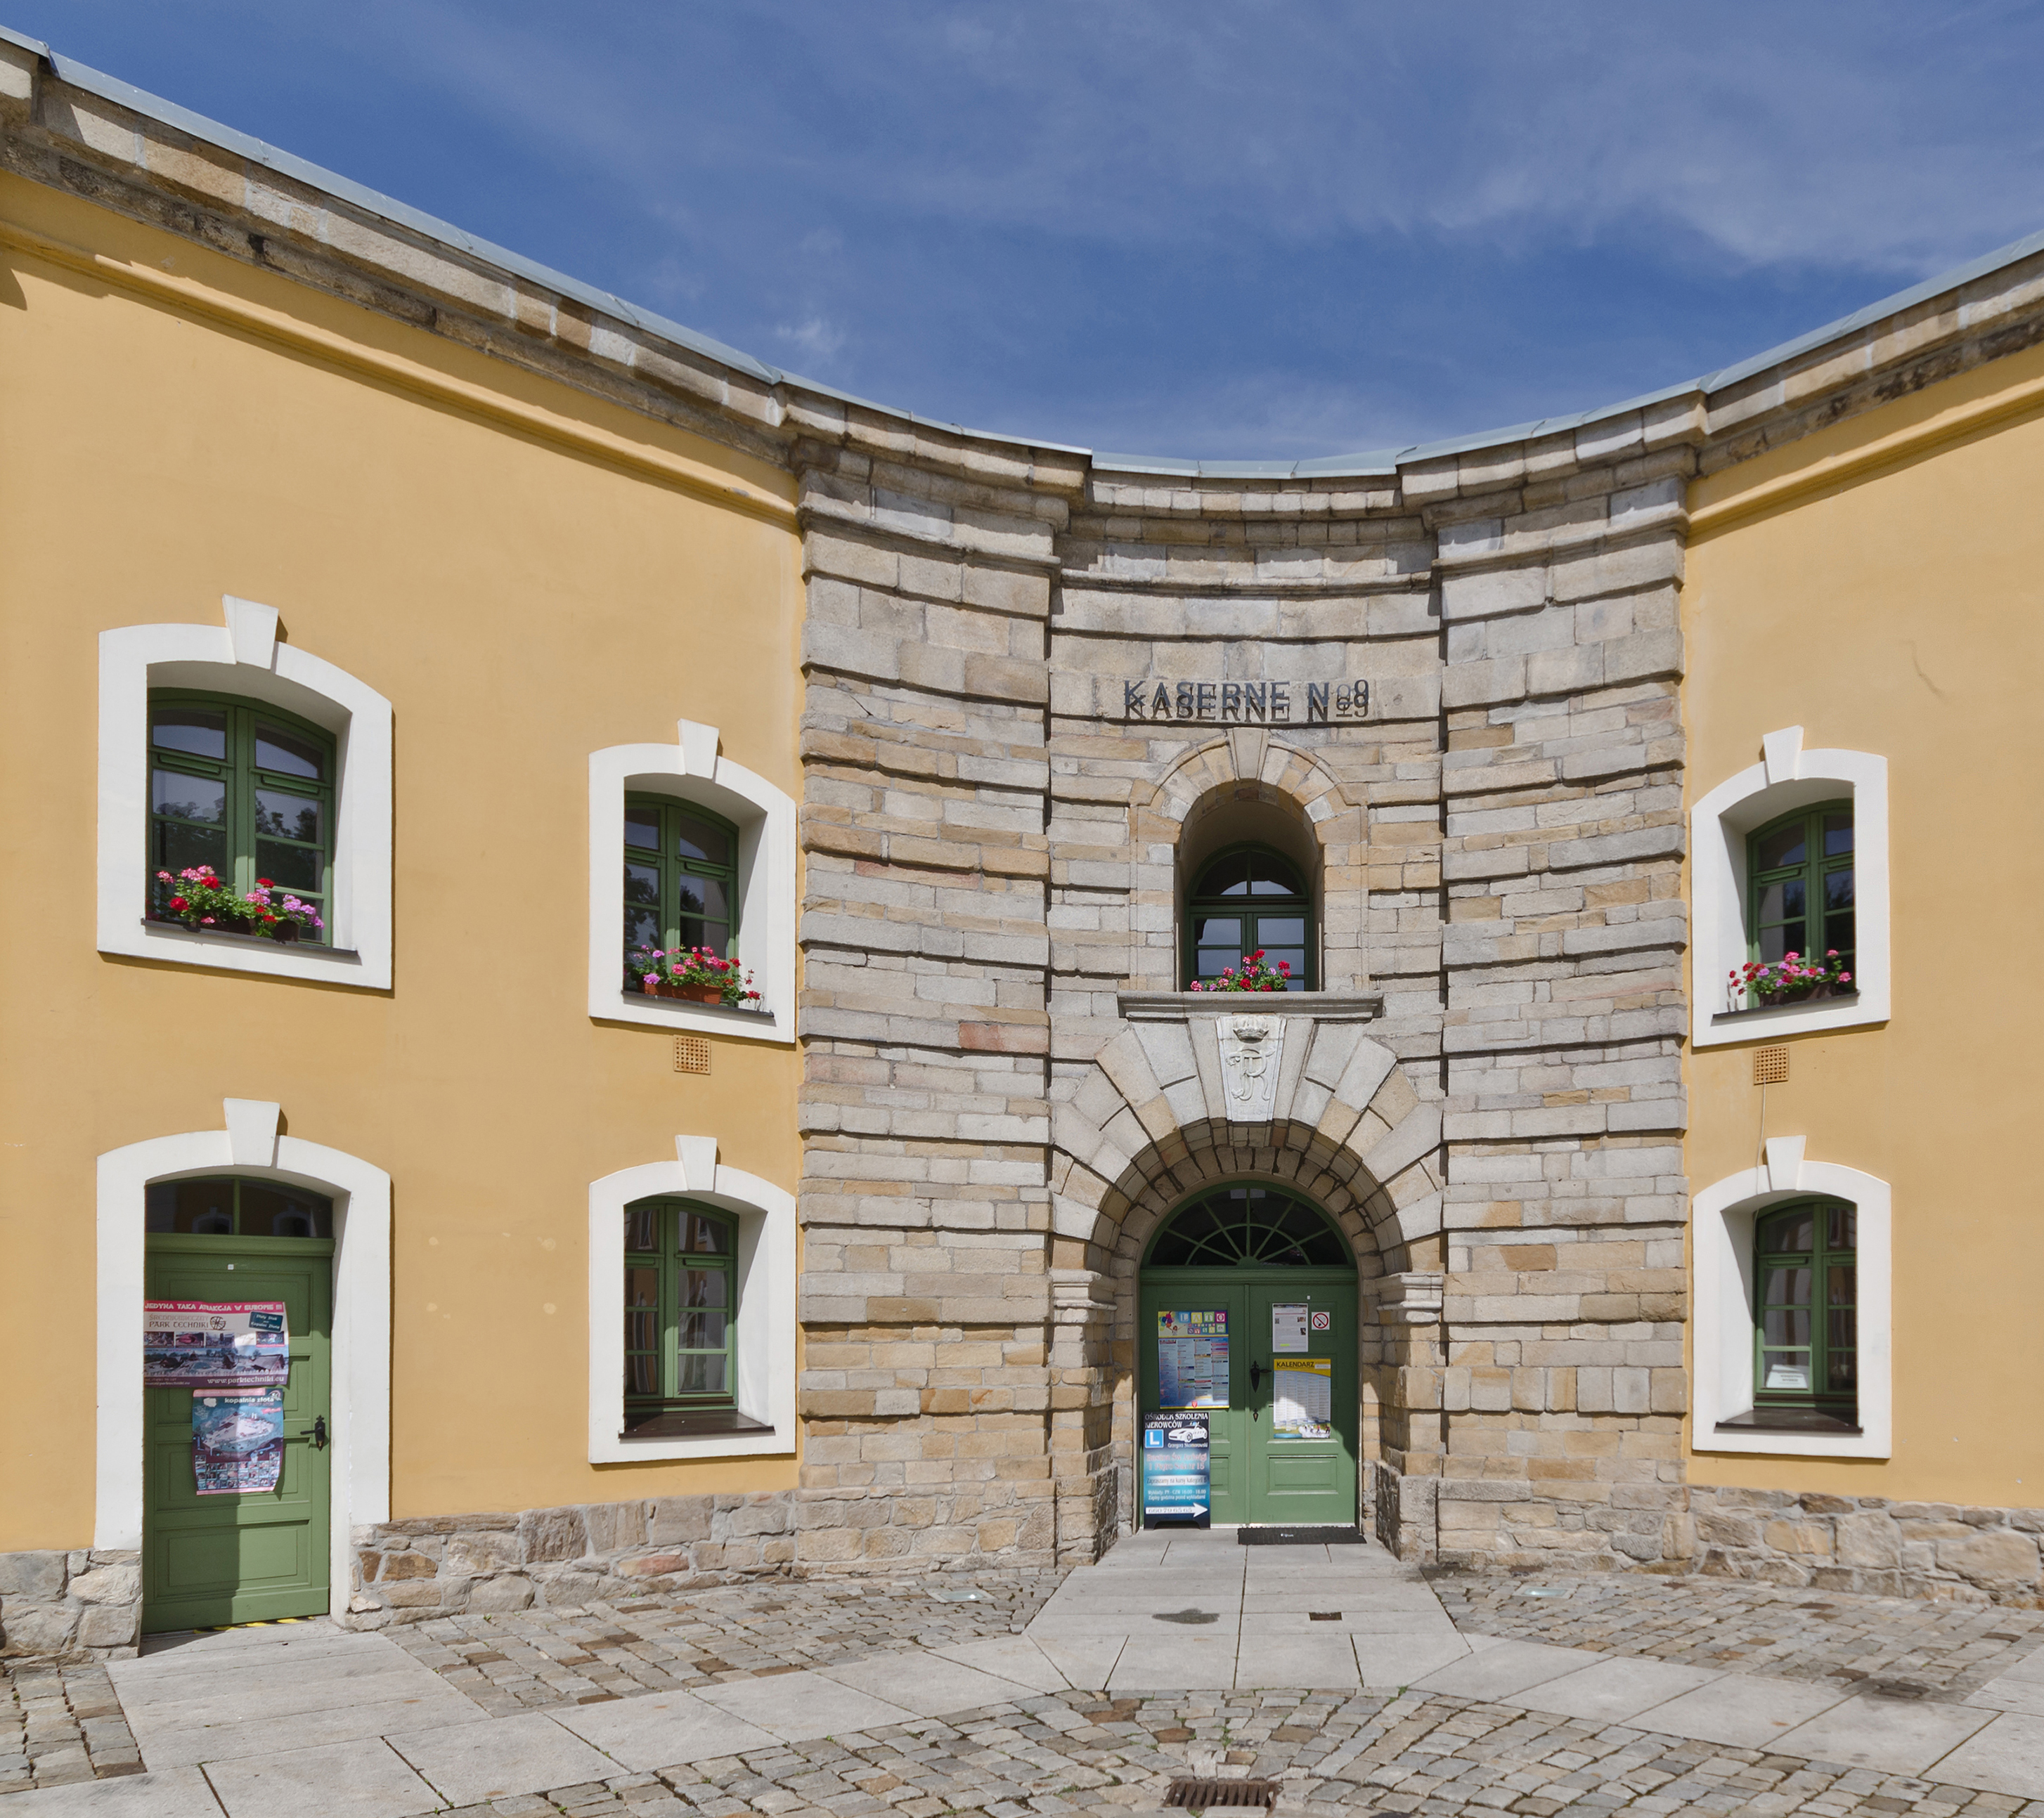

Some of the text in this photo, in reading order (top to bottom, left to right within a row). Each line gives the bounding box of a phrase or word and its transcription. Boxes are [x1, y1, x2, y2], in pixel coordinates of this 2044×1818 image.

[1125, 680, 1290, 708] KASERNE
[1180, 1313, 1224, 1322] LATO
[1149, 1431, 1160, 1445] L
